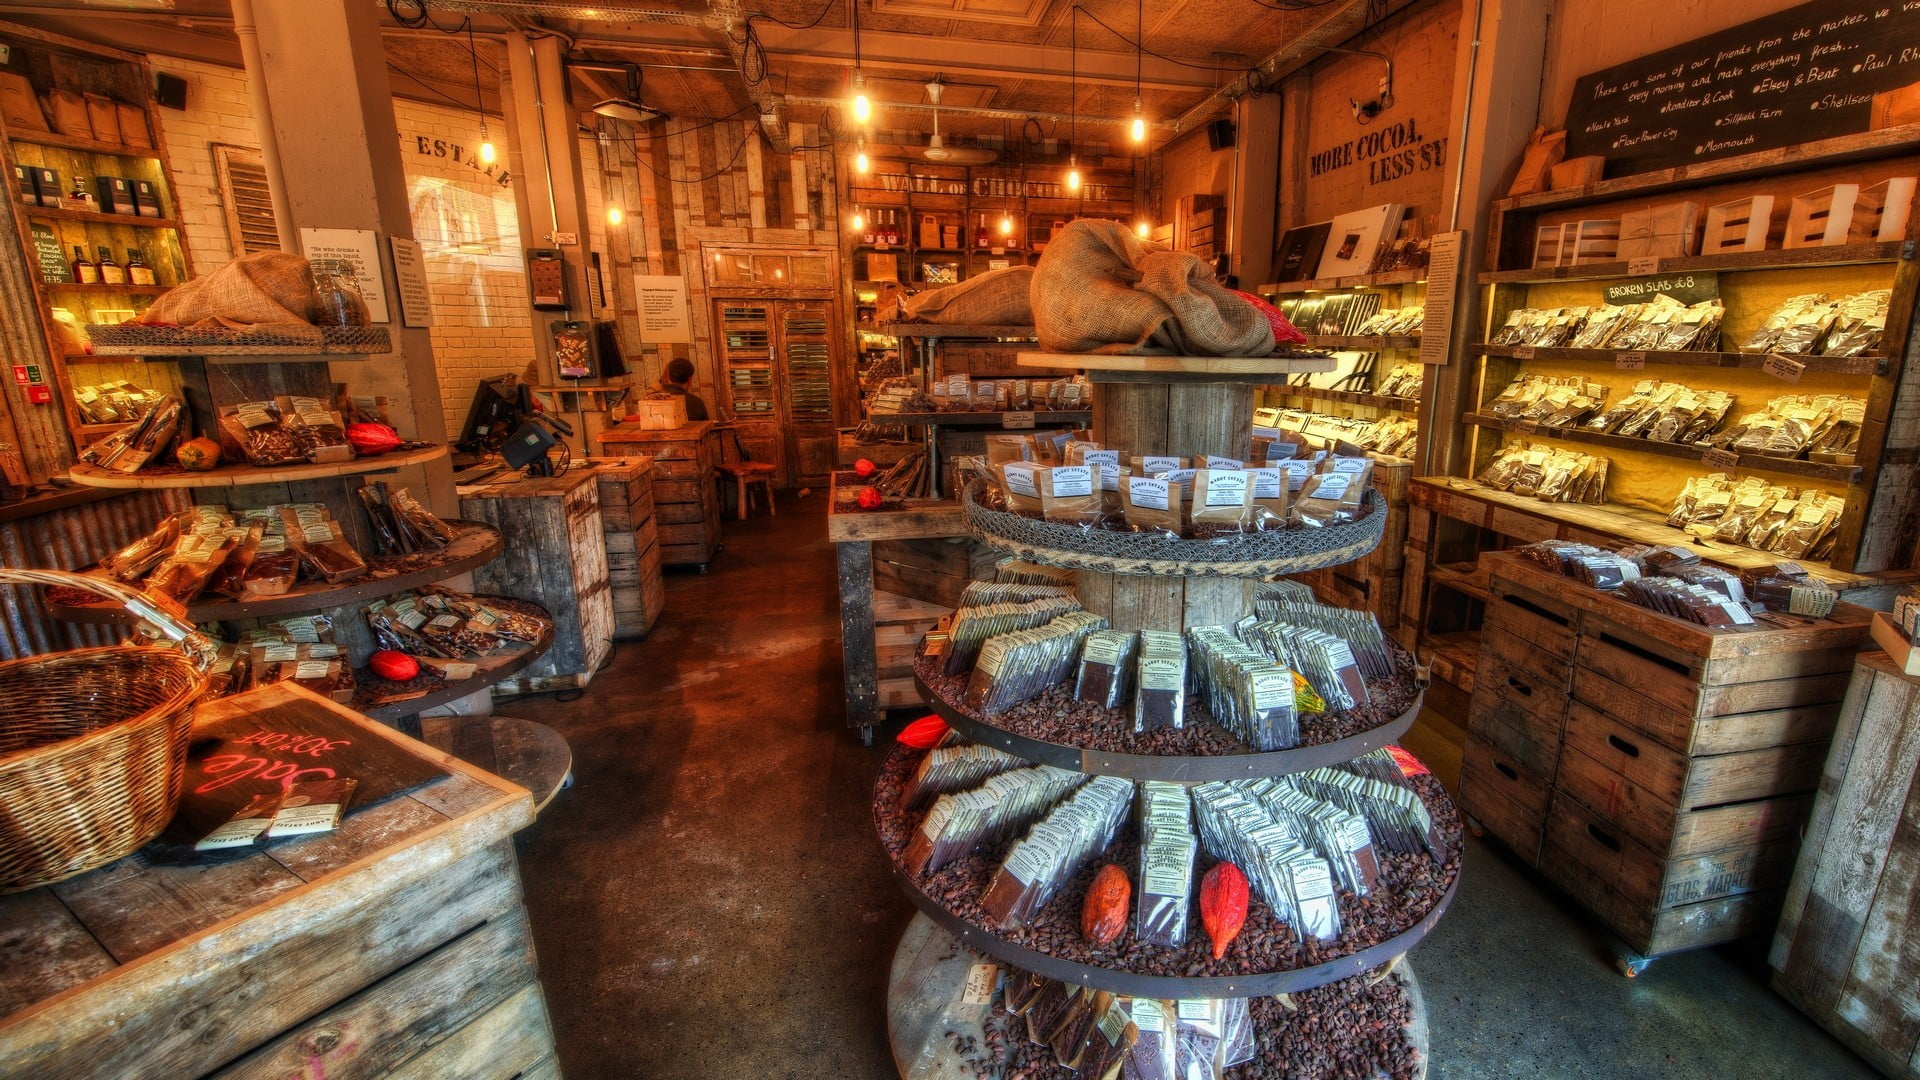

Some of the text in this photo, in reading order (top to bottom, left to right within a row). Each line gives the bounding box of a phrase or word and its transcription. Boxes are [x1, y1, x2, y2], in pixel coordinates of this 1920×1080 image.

[1594, 81, 1618, 100] These
[1622, 79, 1639, 91] are
[1645, 71, 1667, 84] some
[1672, 64, 1684, 77] of
[1691, 57, 1710, 70] our
[1715, 45, 1751, 68] friends
[1792, 29, 1811, 41] the
[1820, 14, 1868, 34] market,
[1862, 47, 1920, 72] Paul Rh
[1628, 90, 1650, 104] every
[1653, 81, 1685, 96] morning
[1691, 74, 1711, 87] and
[1717, 67, 1744, 81] make
[1751, 53, 1801, 73] everything
[1794, 73, 1804, 86] &
[1807, 66, 1840, 83] Bent
[1702, 93, 1711, 106] &
[1713, 89, 1736, 103] Cook
[1758, 108, 1783, 120] Farm
[1641, 129, 1661, 142] Power
[1703, 135, 1755, 155] Monmouth
[1310, 117, 1423, 179] MORE COCOA,
[1369, 149, 1415, 186] LESS
[880, 172, 1108, 202] WALL OF CHOCOLTE
[1646, 281, 1672, 293] SLAB
[1704, 872, 1746, 896] MARKE
